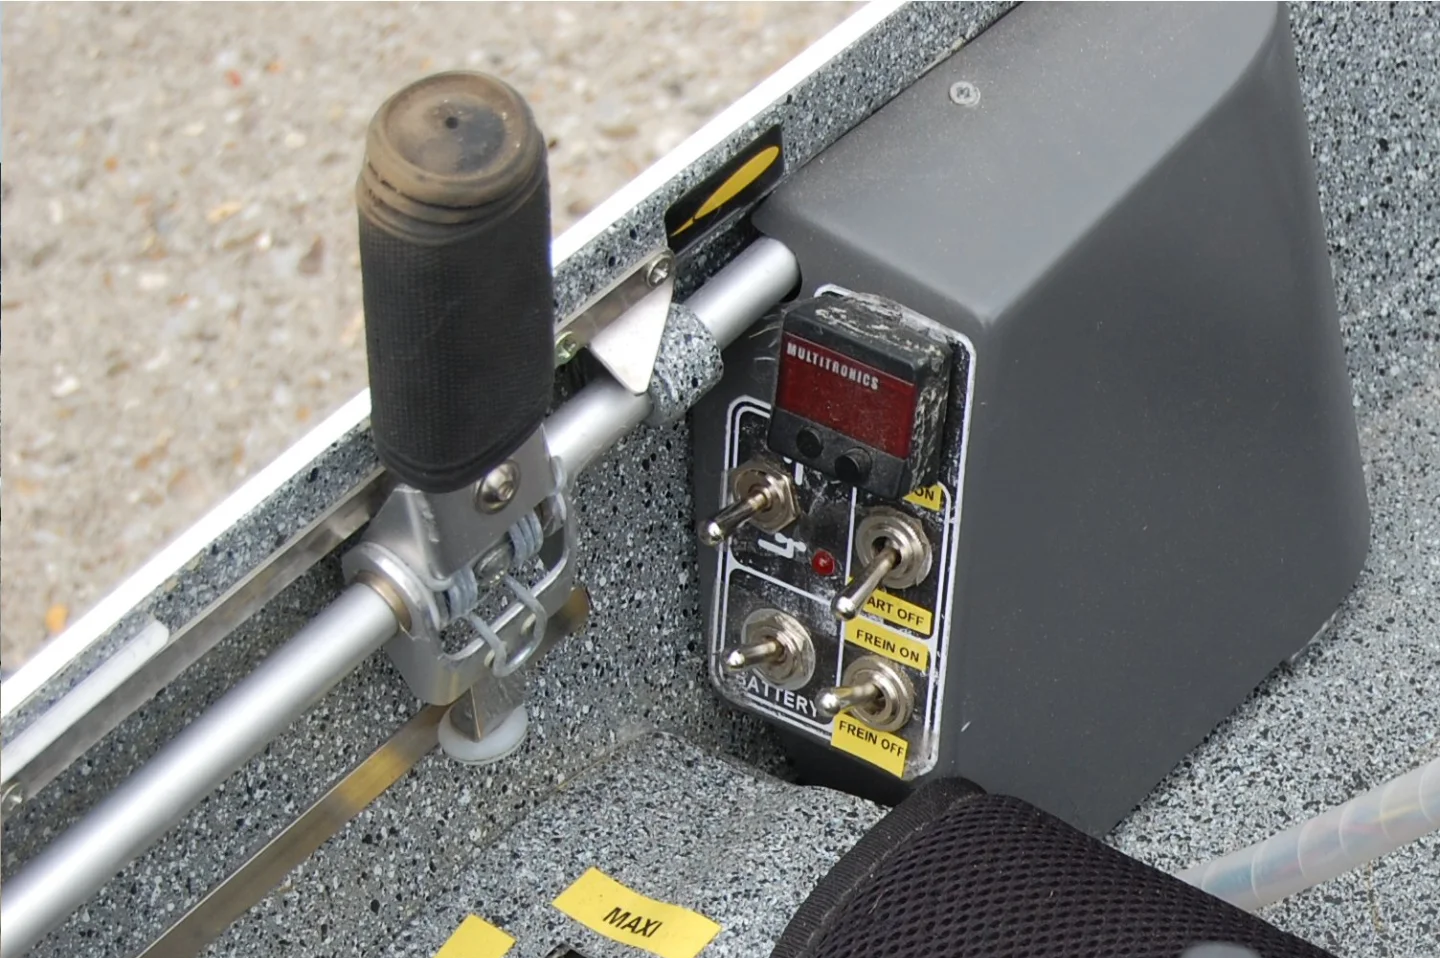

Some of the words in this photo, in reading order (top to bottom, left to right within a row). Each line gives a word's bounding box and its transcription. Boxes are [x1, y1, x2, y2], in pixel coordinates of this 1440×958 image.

[786, 342, 879, 391] MULTITRONICS
[897, 608, 925, 626] OFF
[856, 629, 896, 654] FREIN
[899, 646, 920, 663] ON
[838, 720, 878, 744] FREIN
[881, 736, 905, 757] OFF
[602, 906, 664, 938] MAXI
